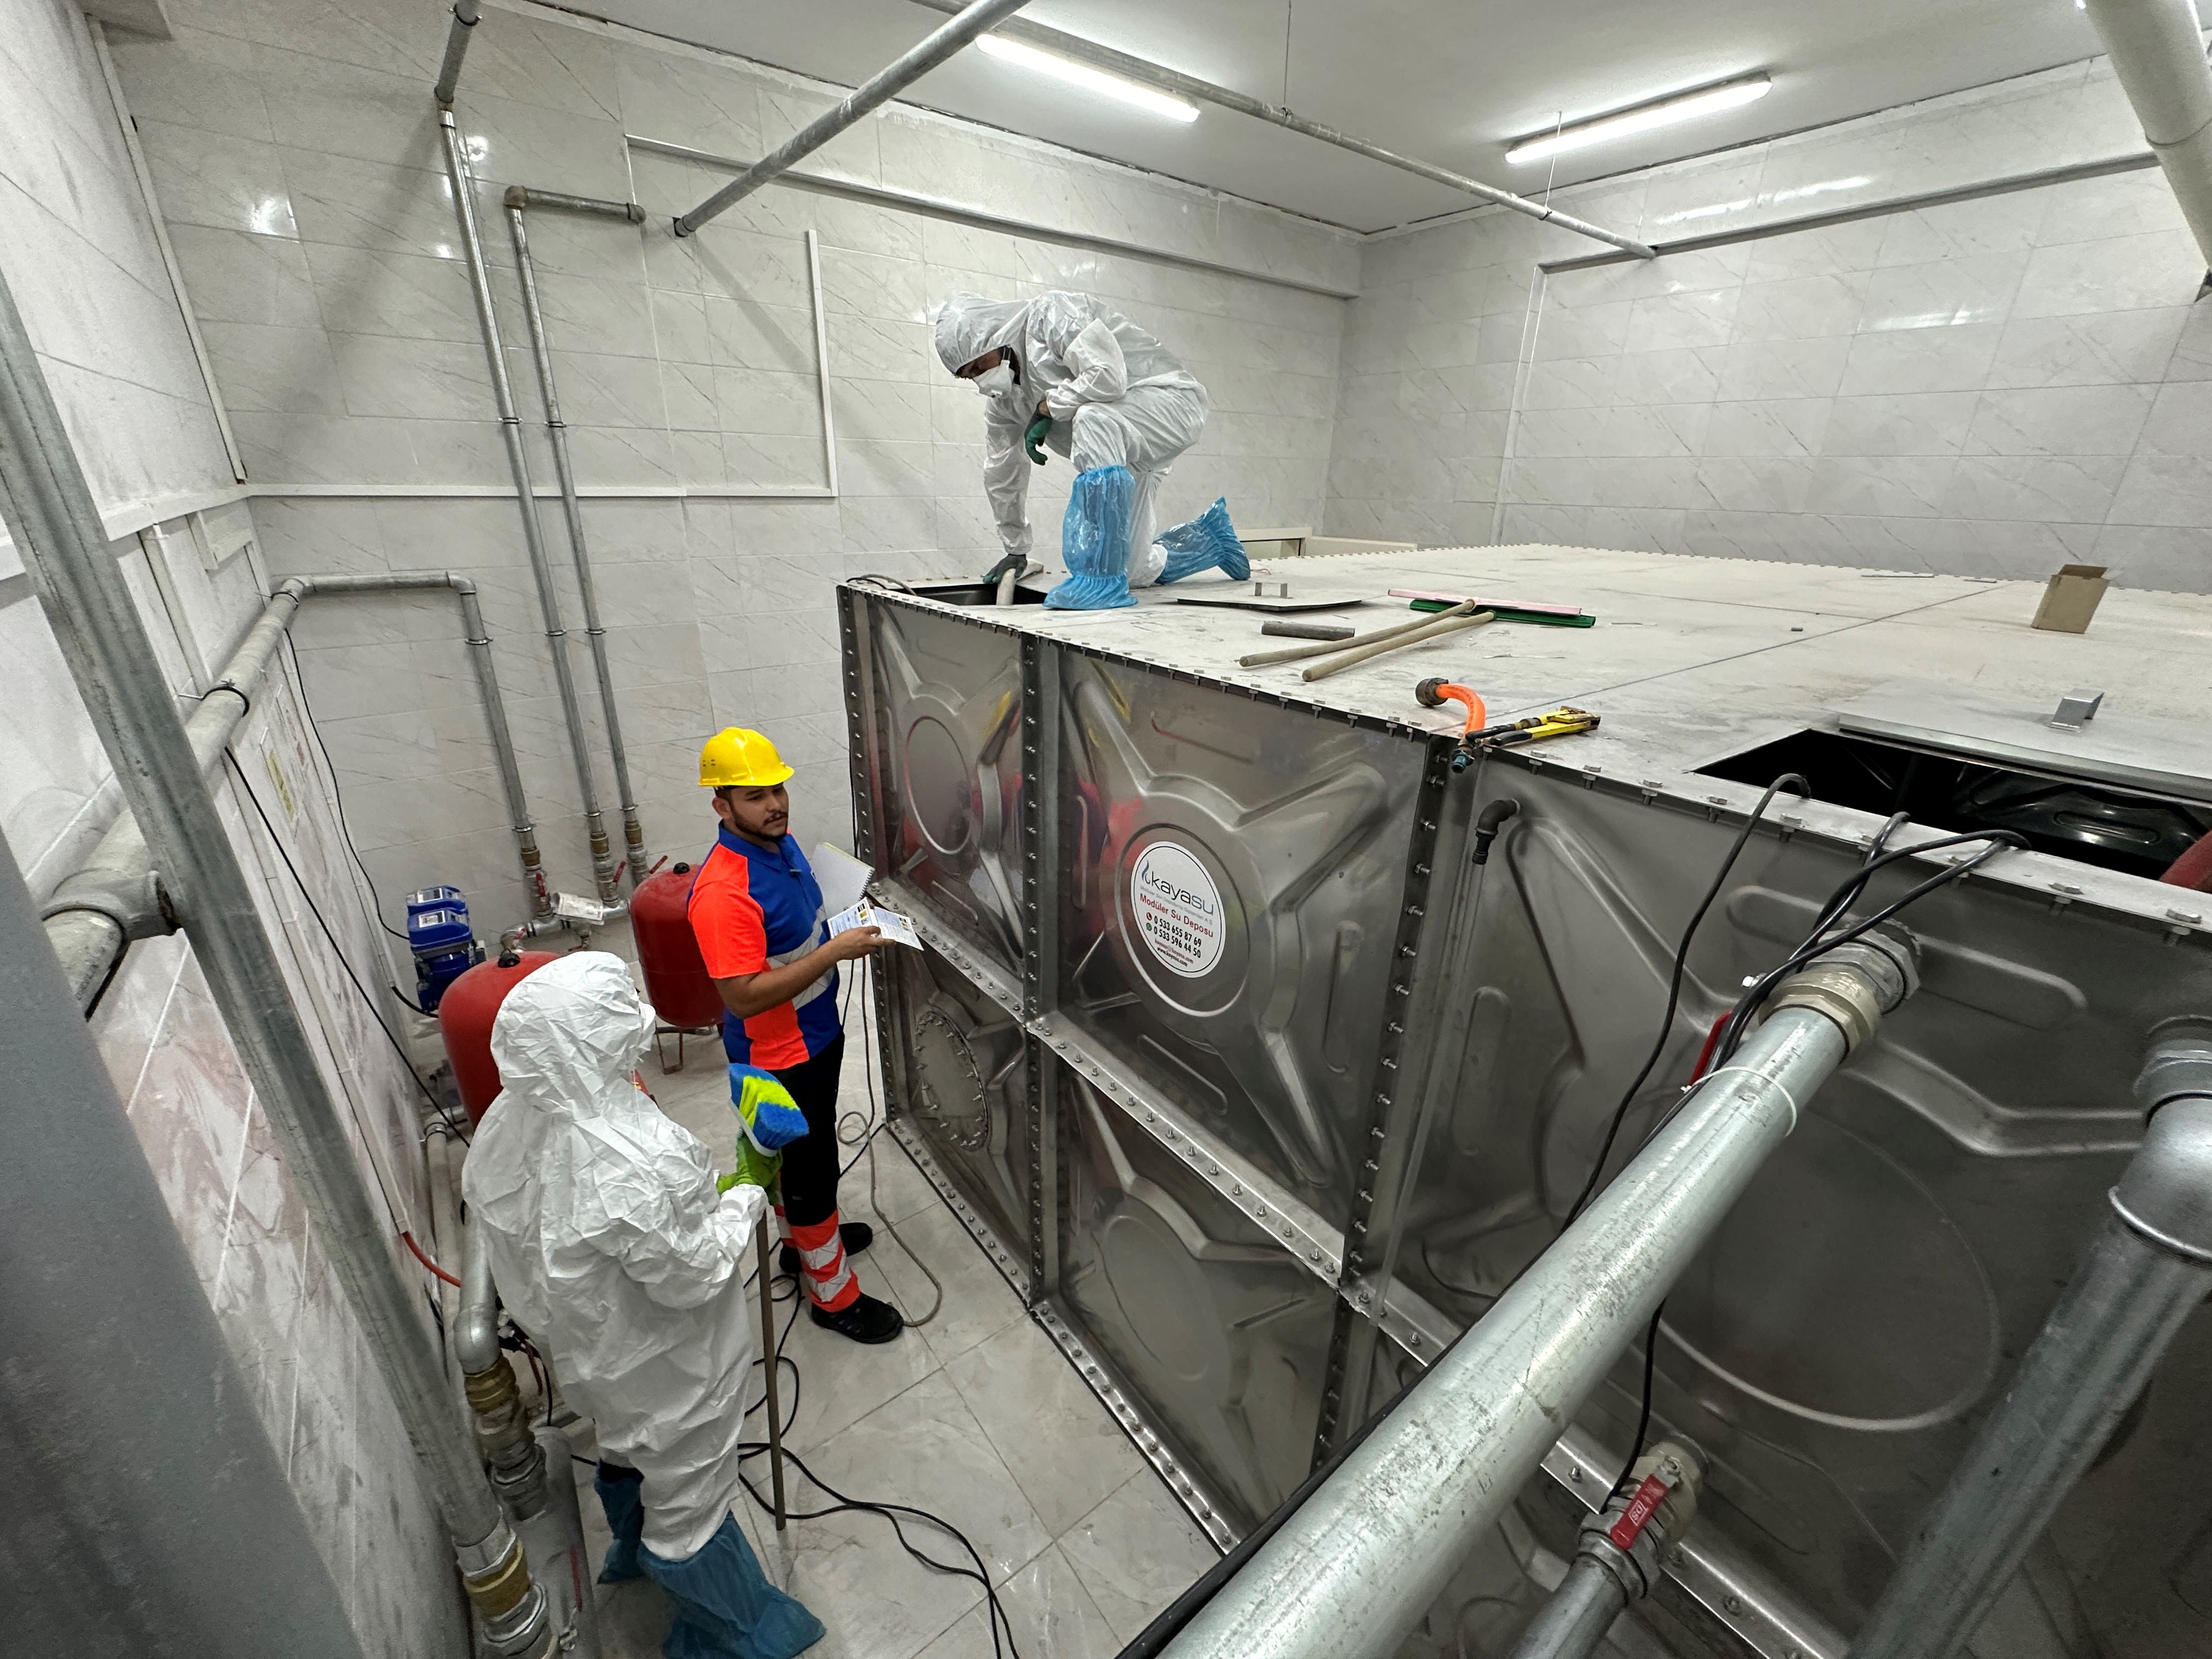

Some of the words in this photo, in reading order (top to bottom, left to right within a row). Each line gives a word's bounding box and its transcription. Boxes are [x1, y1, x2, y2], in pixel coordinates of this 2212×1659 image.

[1152, 871, 1214, 915] kayasu
[1140, 893, 1169, 914] Modüler
[1171, 909, 1181, 921] Su
[1184, 916, 1213, 937] Deposu
[1154, 916, 1158, 924] 0
[1160, 919, 1170, 930] 533
[1172, 924, 1183, 937] 655
[1184, 932, 1192, 941] 87
[1194, 936, 1201, 947] 69
[1159, 930, 1170, 942] 533
[1171, 936, 1182, 948] 596
[1184, 943, 1191, 953] 44
[1193, 948, 1201, 958] 50
